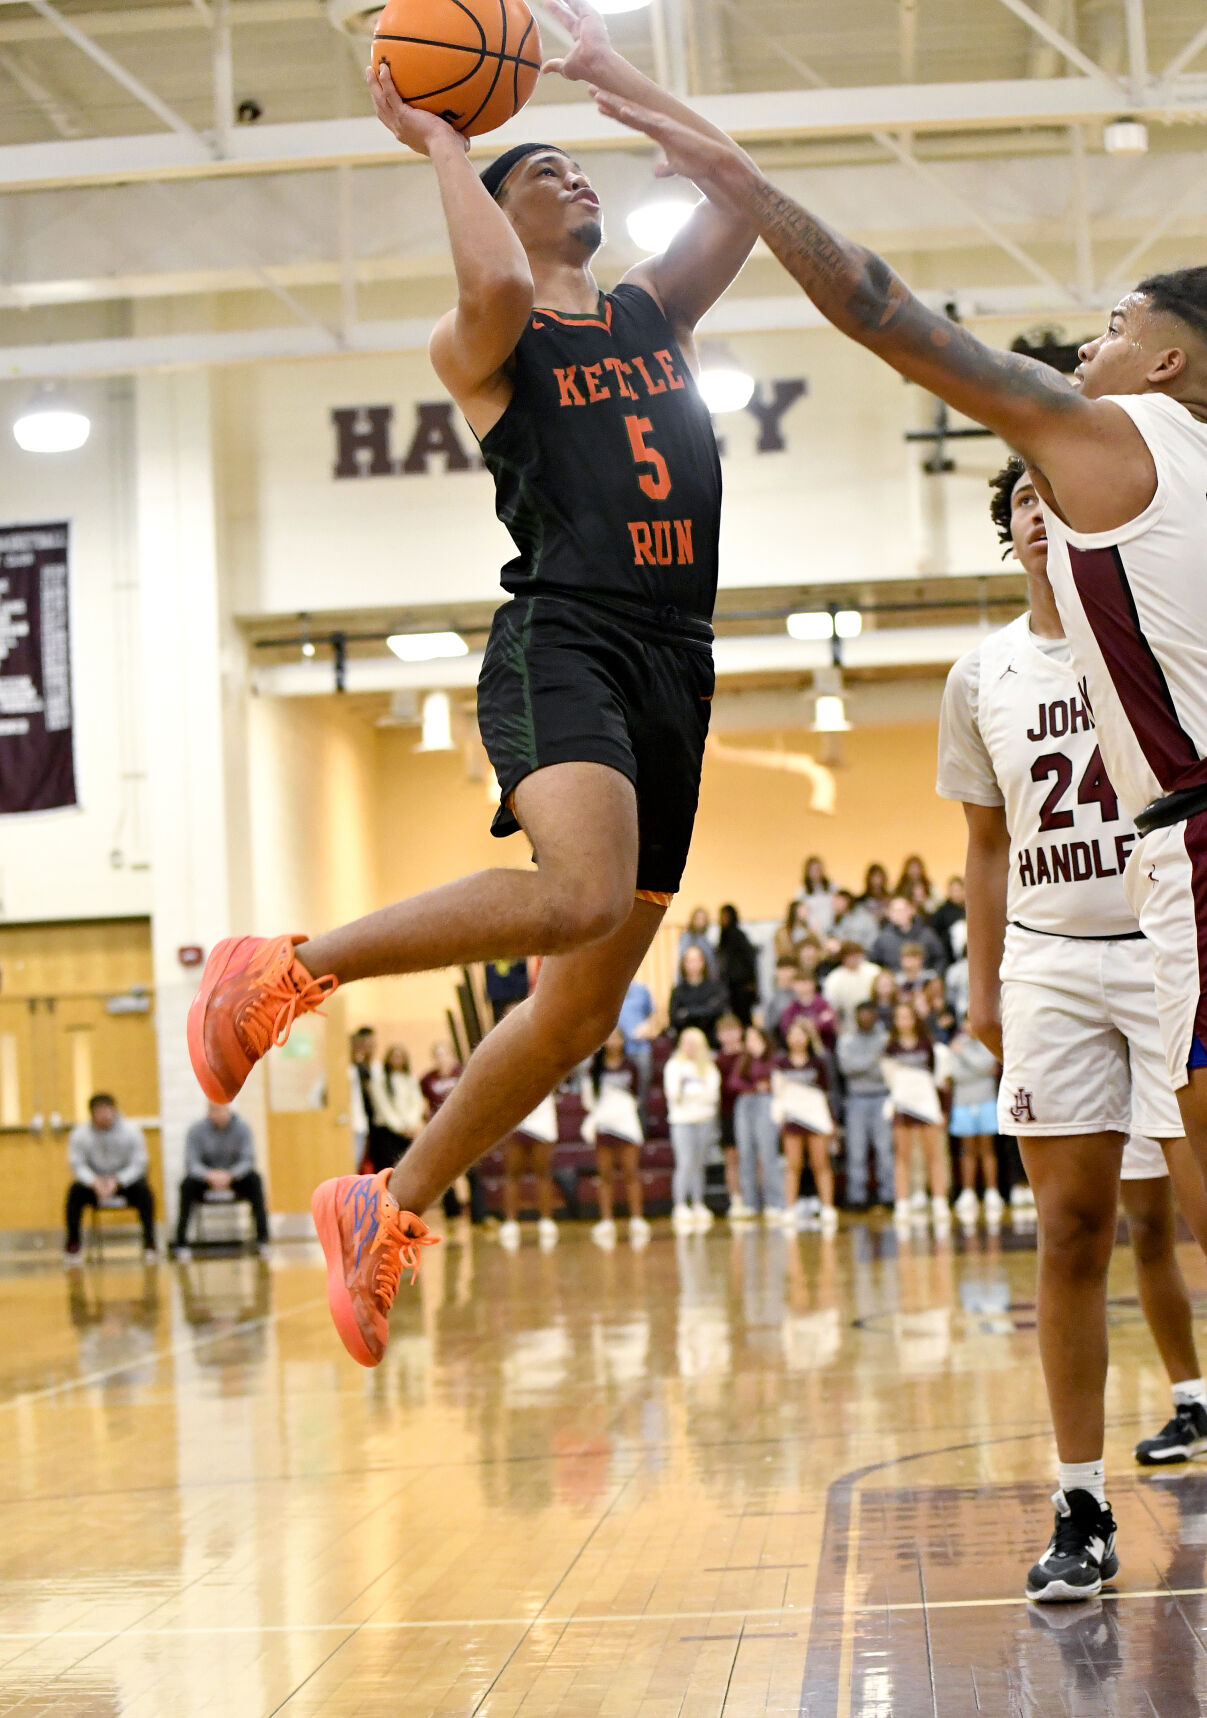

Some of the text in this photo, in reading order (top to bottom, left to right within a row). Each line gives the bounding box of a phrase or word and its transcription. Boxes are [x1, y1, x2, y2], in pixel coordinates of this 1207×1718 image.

[624, 415, 672, 500] 5
[627, 519, 694, 565] RUN
[1027, 696, 1096, 742] JOH
[1030, 744, 1120, 833] 24
[1018, 832, 1144, 887] HANDLE
